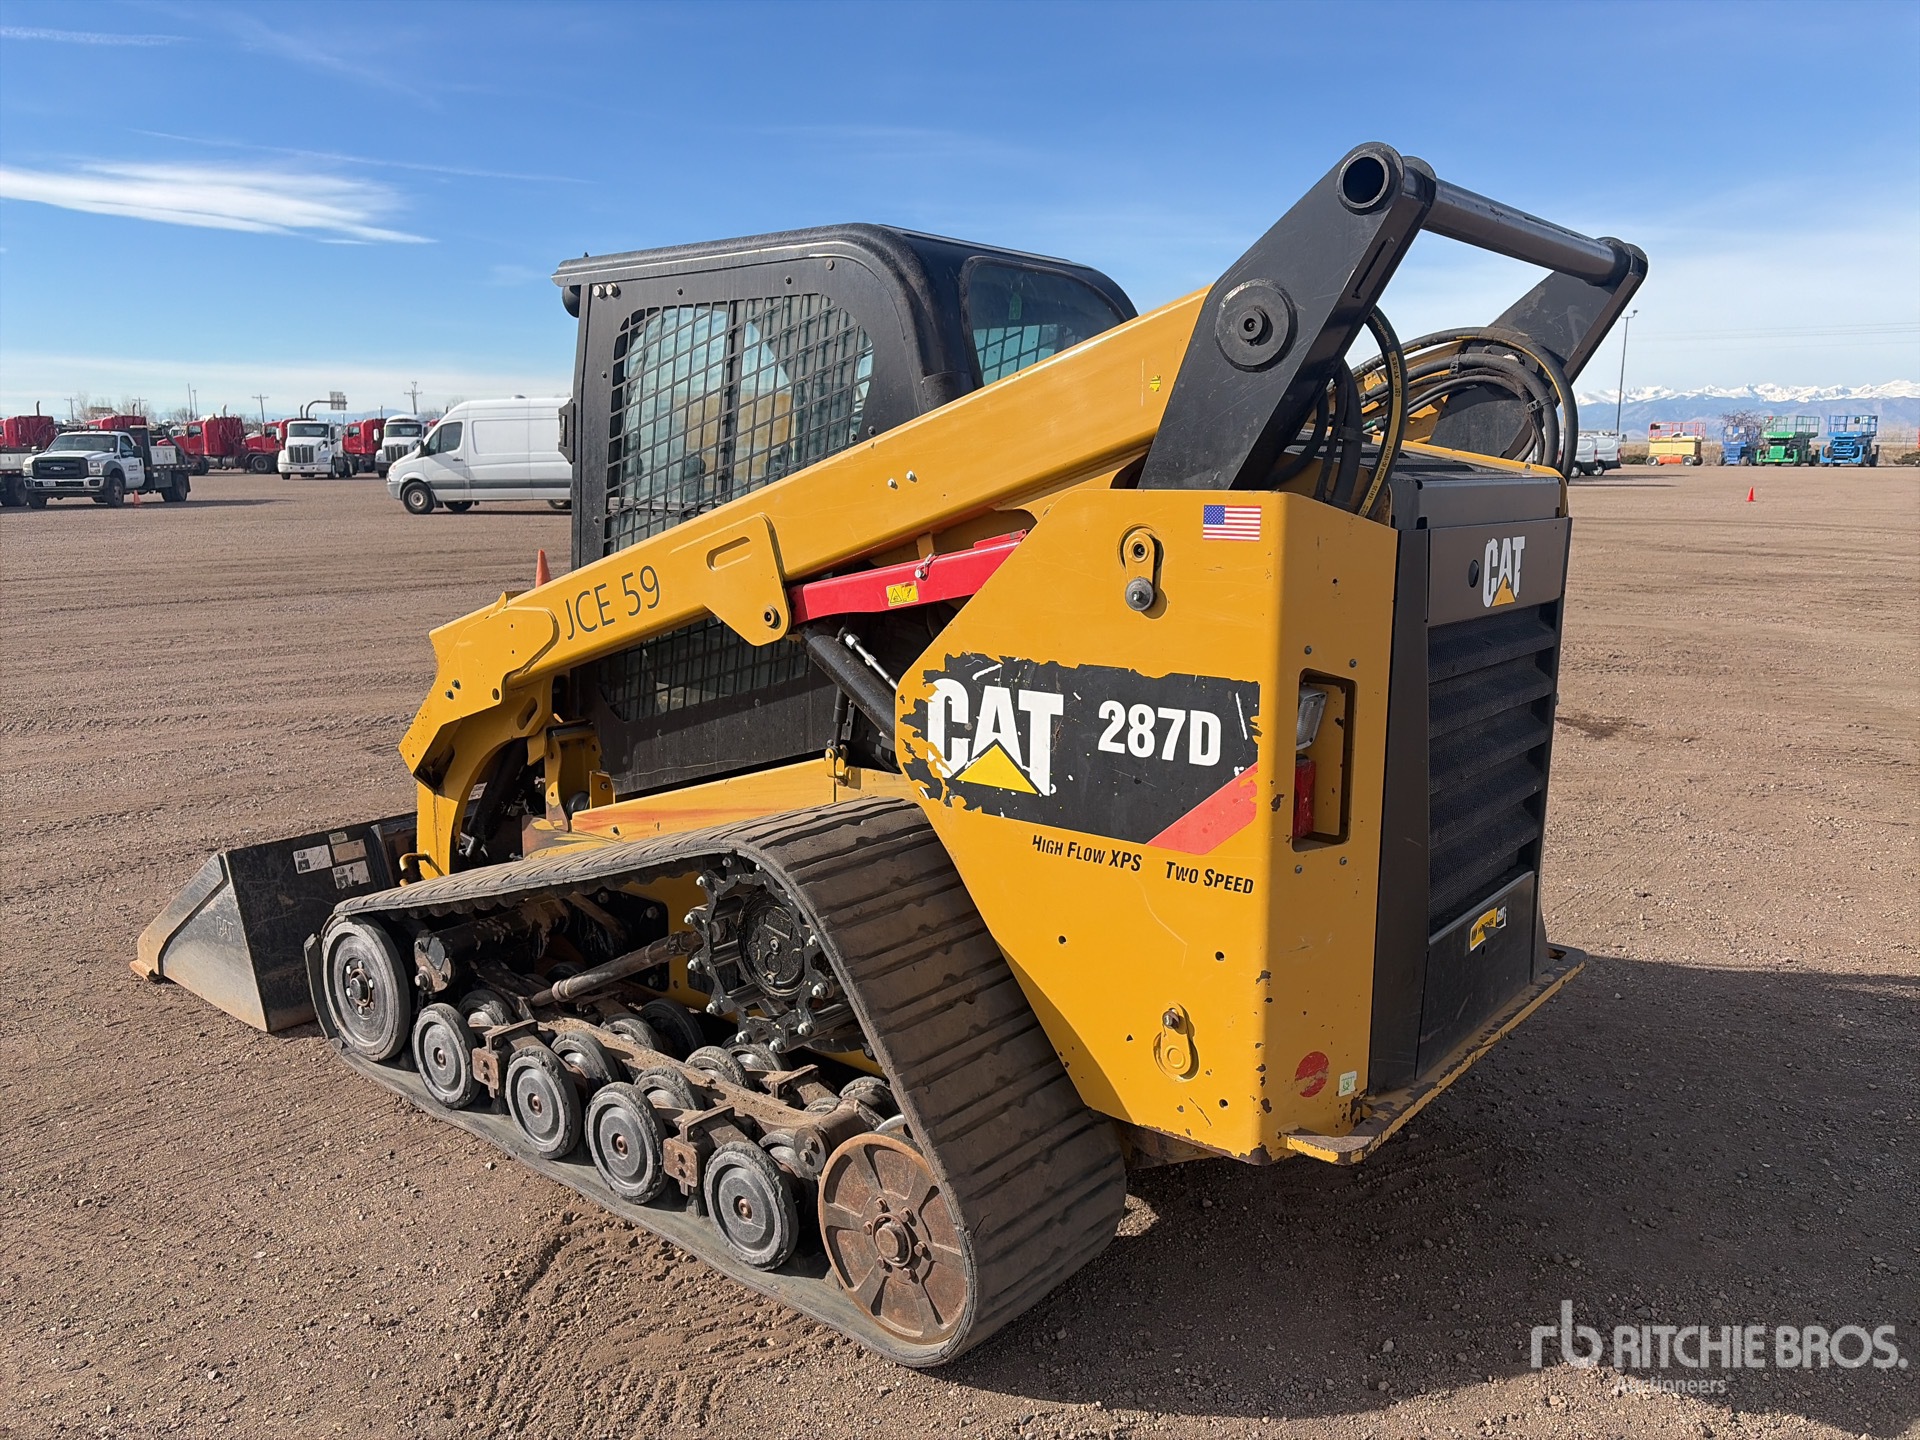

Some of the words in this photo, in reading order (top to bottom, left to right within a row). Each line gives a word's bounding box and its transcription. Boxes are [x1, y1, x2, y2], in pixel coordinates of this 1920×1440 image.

[565, 583, 616, 640] JCE
[621, 565, 661, 617] 59
[1483, 536, 1526, 608] CAT
[928, 678, 1064, 796] CAT
[1097, 700, 1222, 767] 287D
[1032, 835, 1063, 856] HIGH
[1066, 841, 1106, 865] FLOW
[1108, 849, 1142, 872] XPS
[1165, 860, 1199, 884] TWO
[1203, 868, 1254, 894] SPEED
